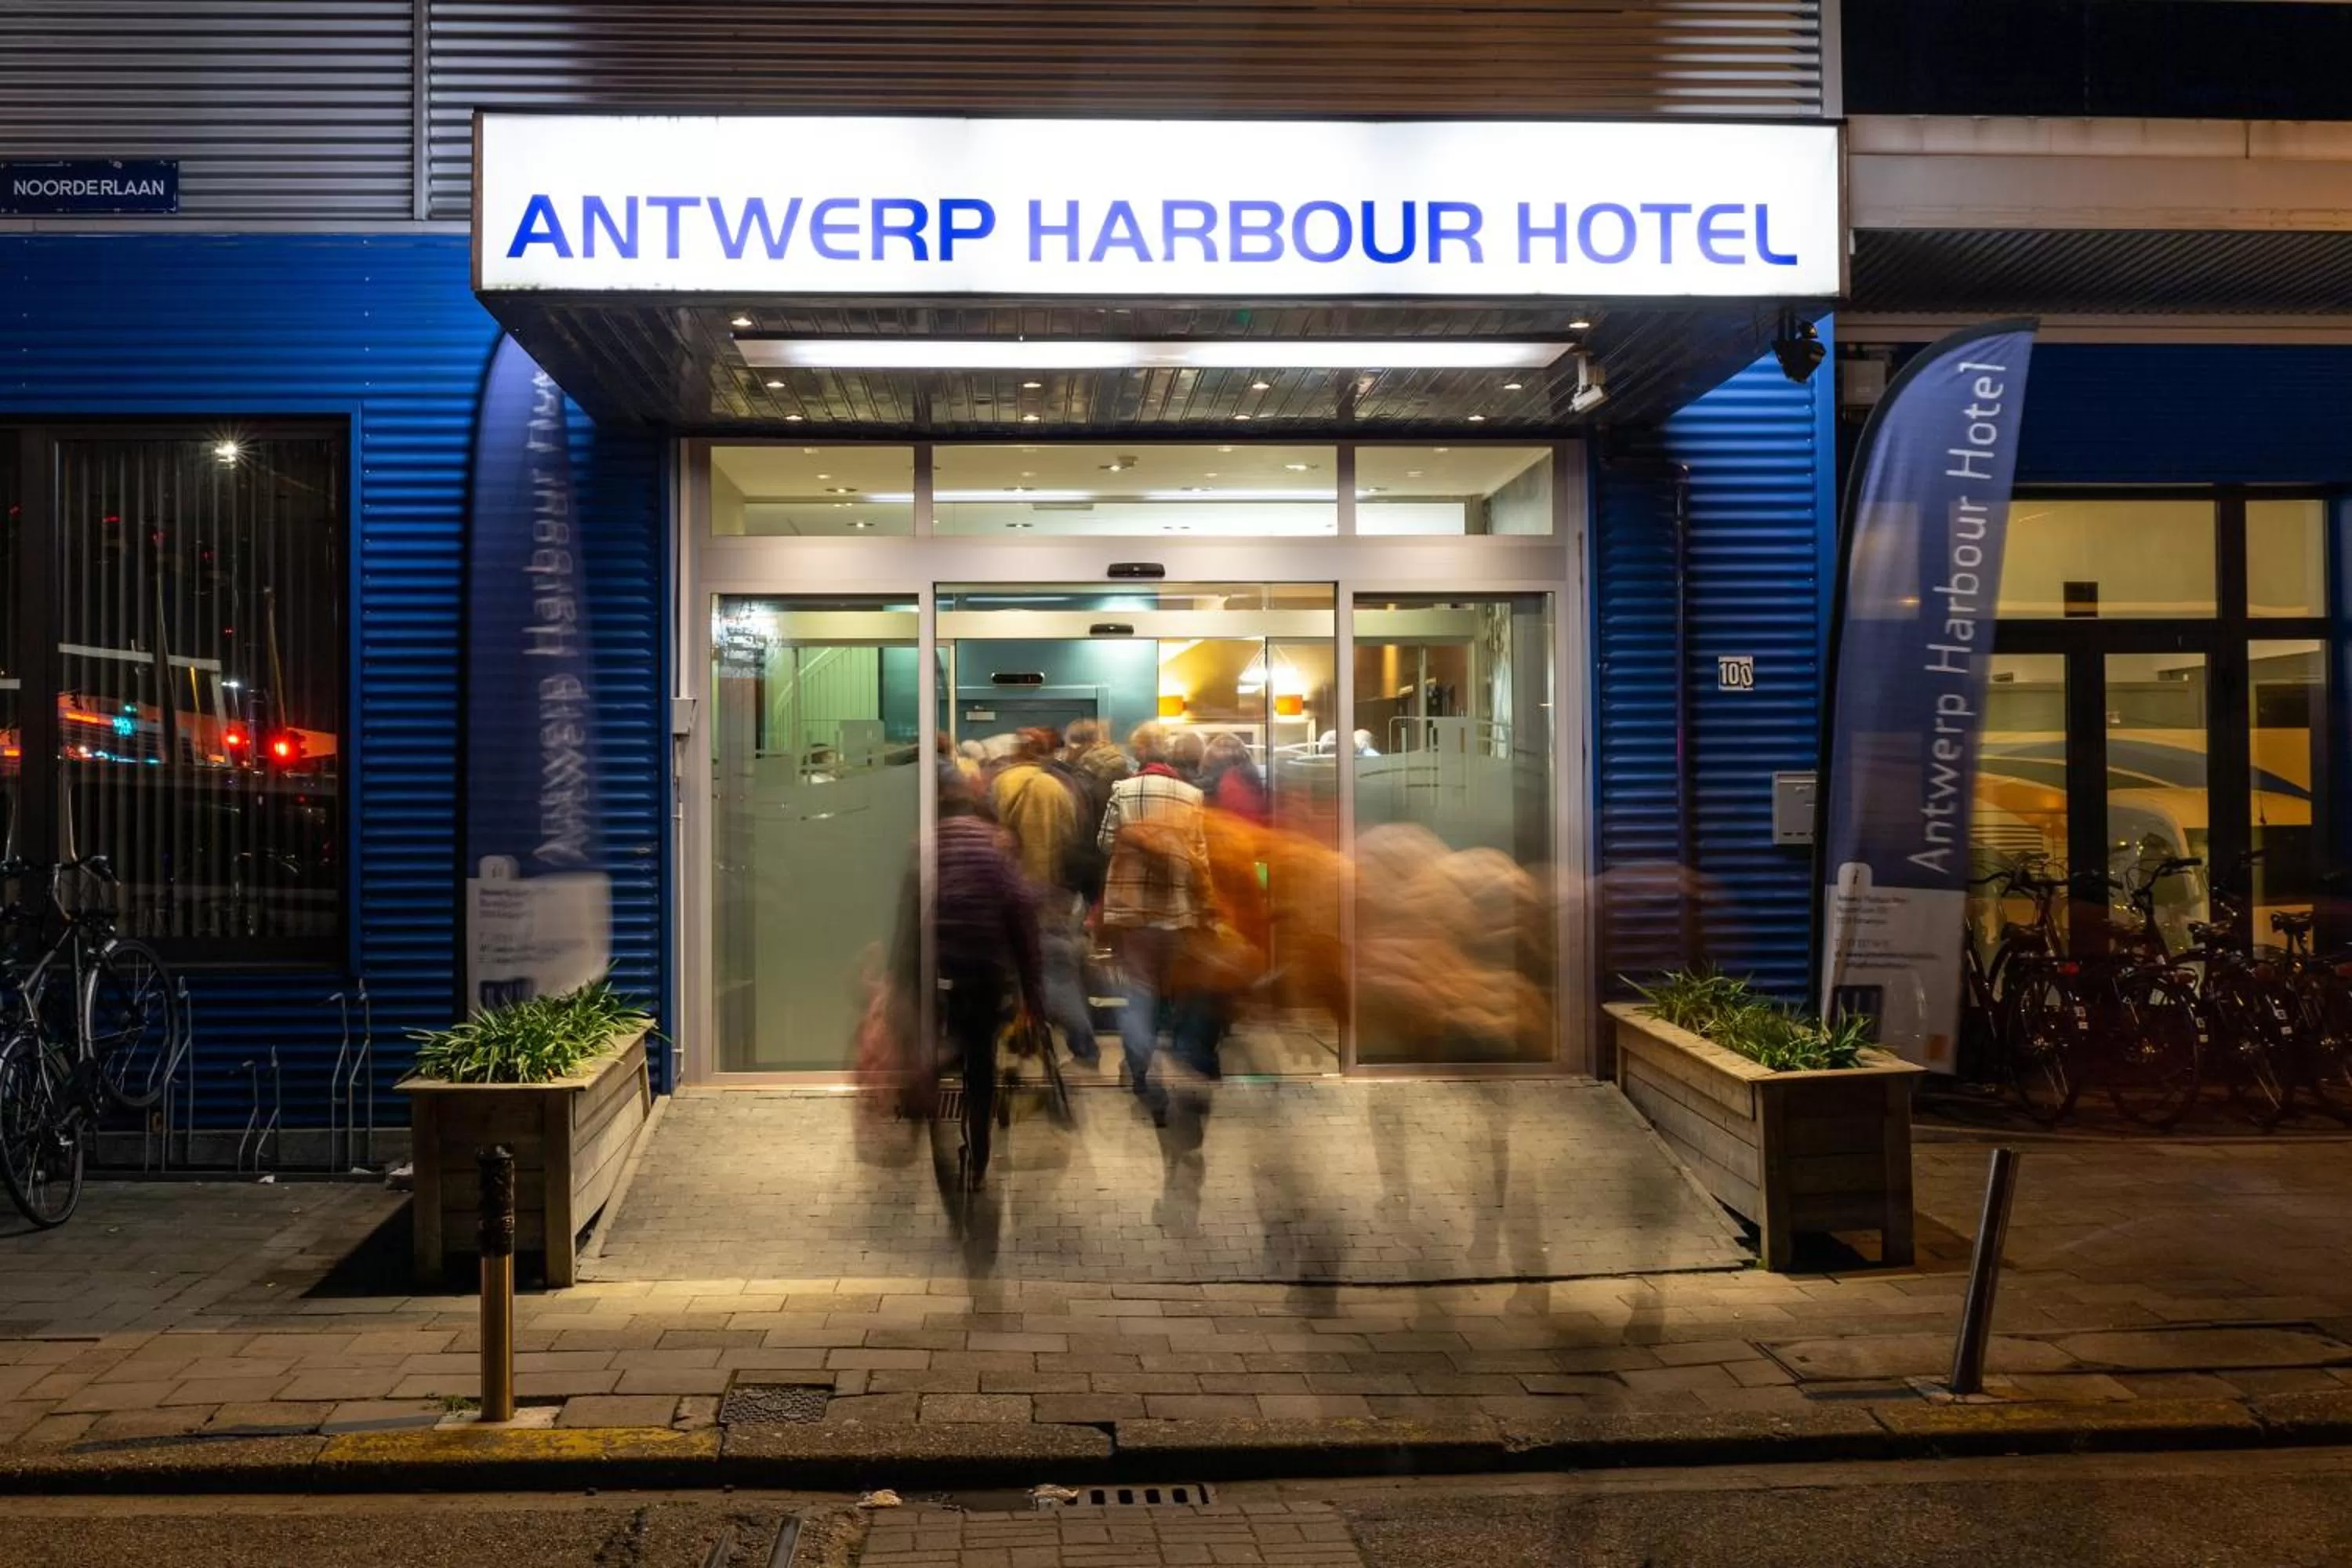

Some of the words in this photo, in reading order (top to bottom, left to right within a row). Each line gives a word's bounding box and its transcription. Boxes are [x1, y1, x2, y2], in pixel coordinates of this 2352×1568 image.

[13, 180, 164, 196] NOORDERLAAN
[506, 194, 996, 262] ANTWERP
[1028, 199, 1485, 263] HARBOUR
[1517, 201, 1798, 265] HOTEL
[1945, 361, 2007, 479] Hotel
[522, 467, 580, 657] Harbour
[1923, 495, 1989, 674] Harbour
[1719, 662, 1754, 686] 100
[1907, 693, 1976, 875] Antwerp
